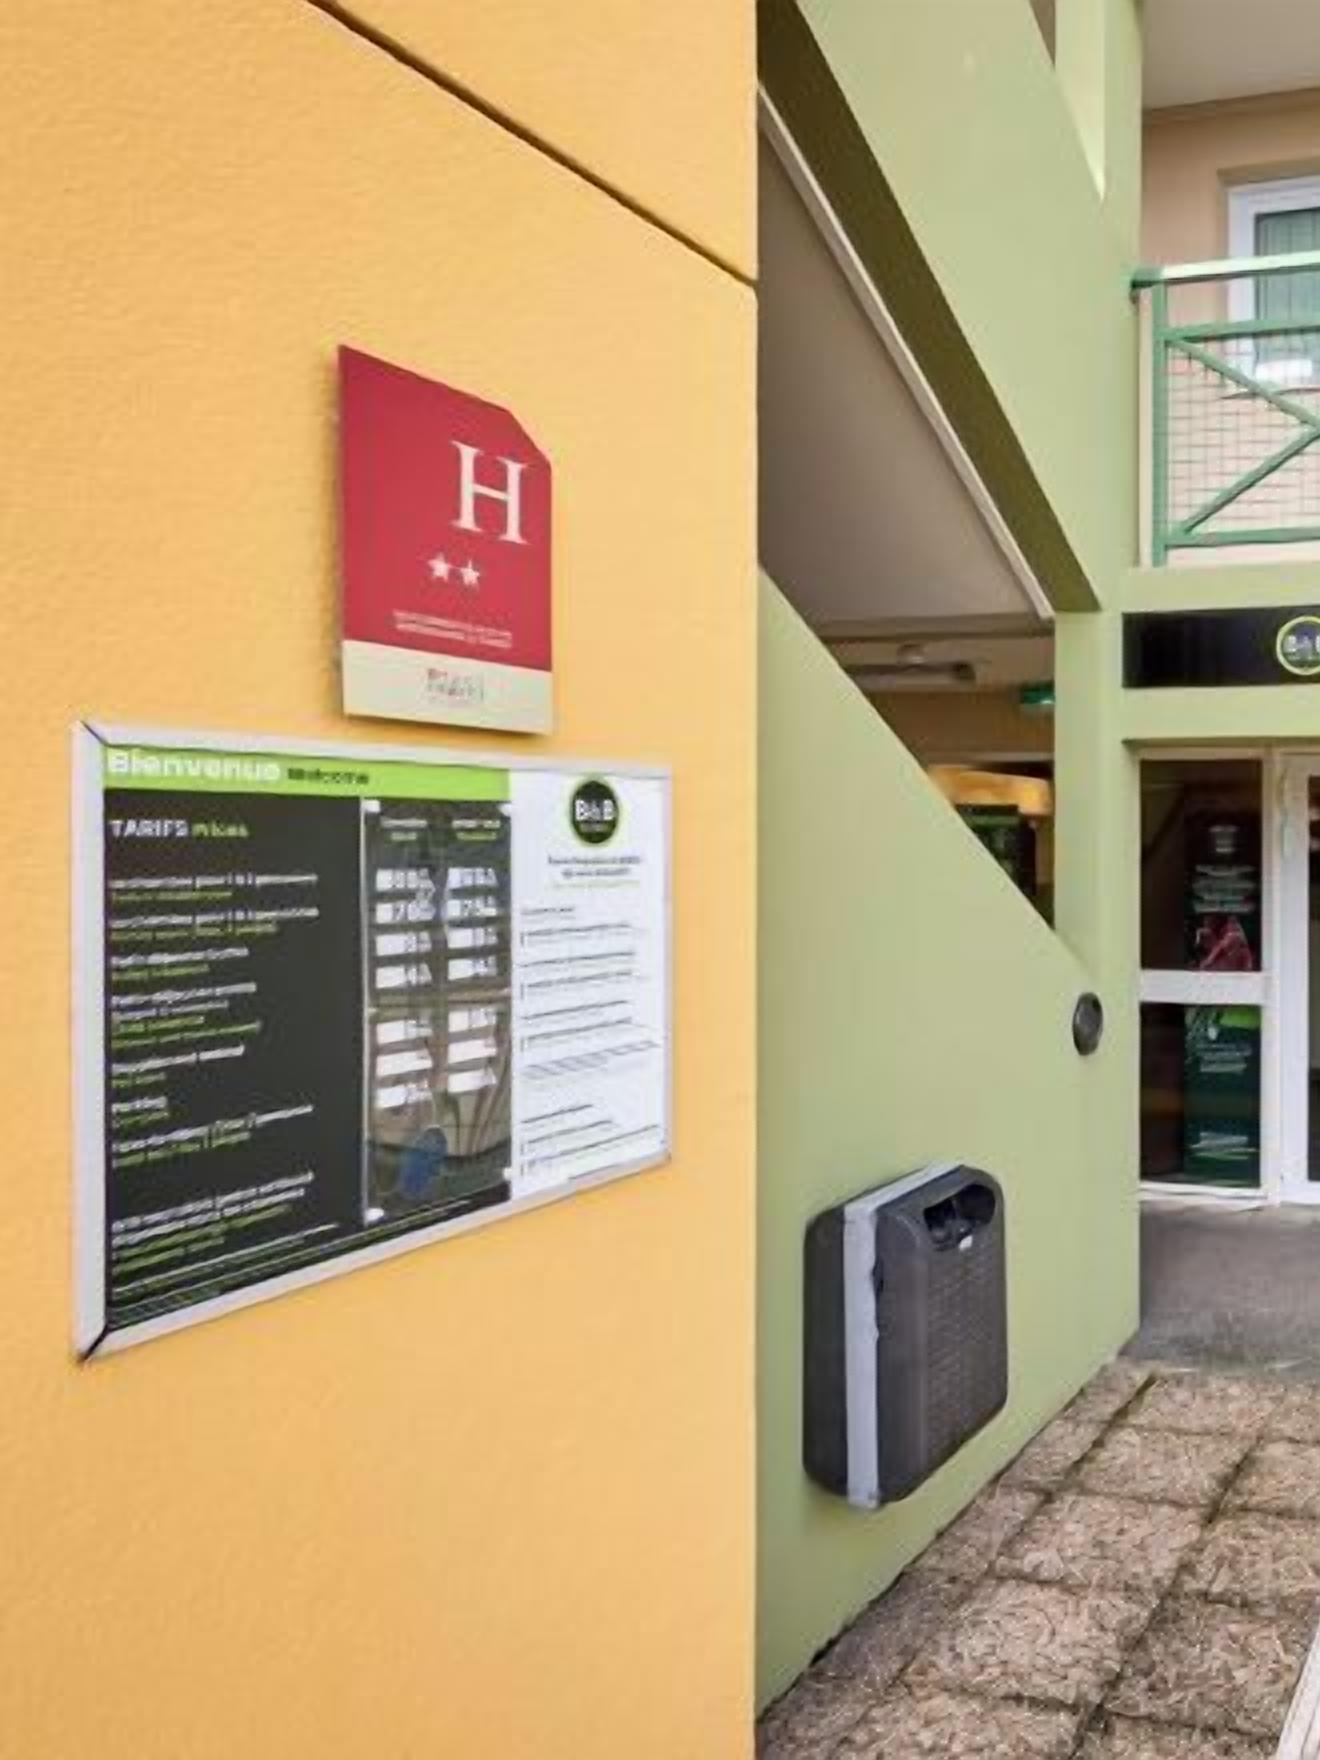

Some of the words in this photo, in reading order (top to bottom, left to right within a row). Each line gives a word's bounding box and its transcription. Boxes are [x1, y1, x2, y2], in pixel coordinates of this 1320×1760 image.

[450, 440, 533, 546] H
[106, 749, 281, 781] Bienvenue
[288, 767, 369, 785] lcom
